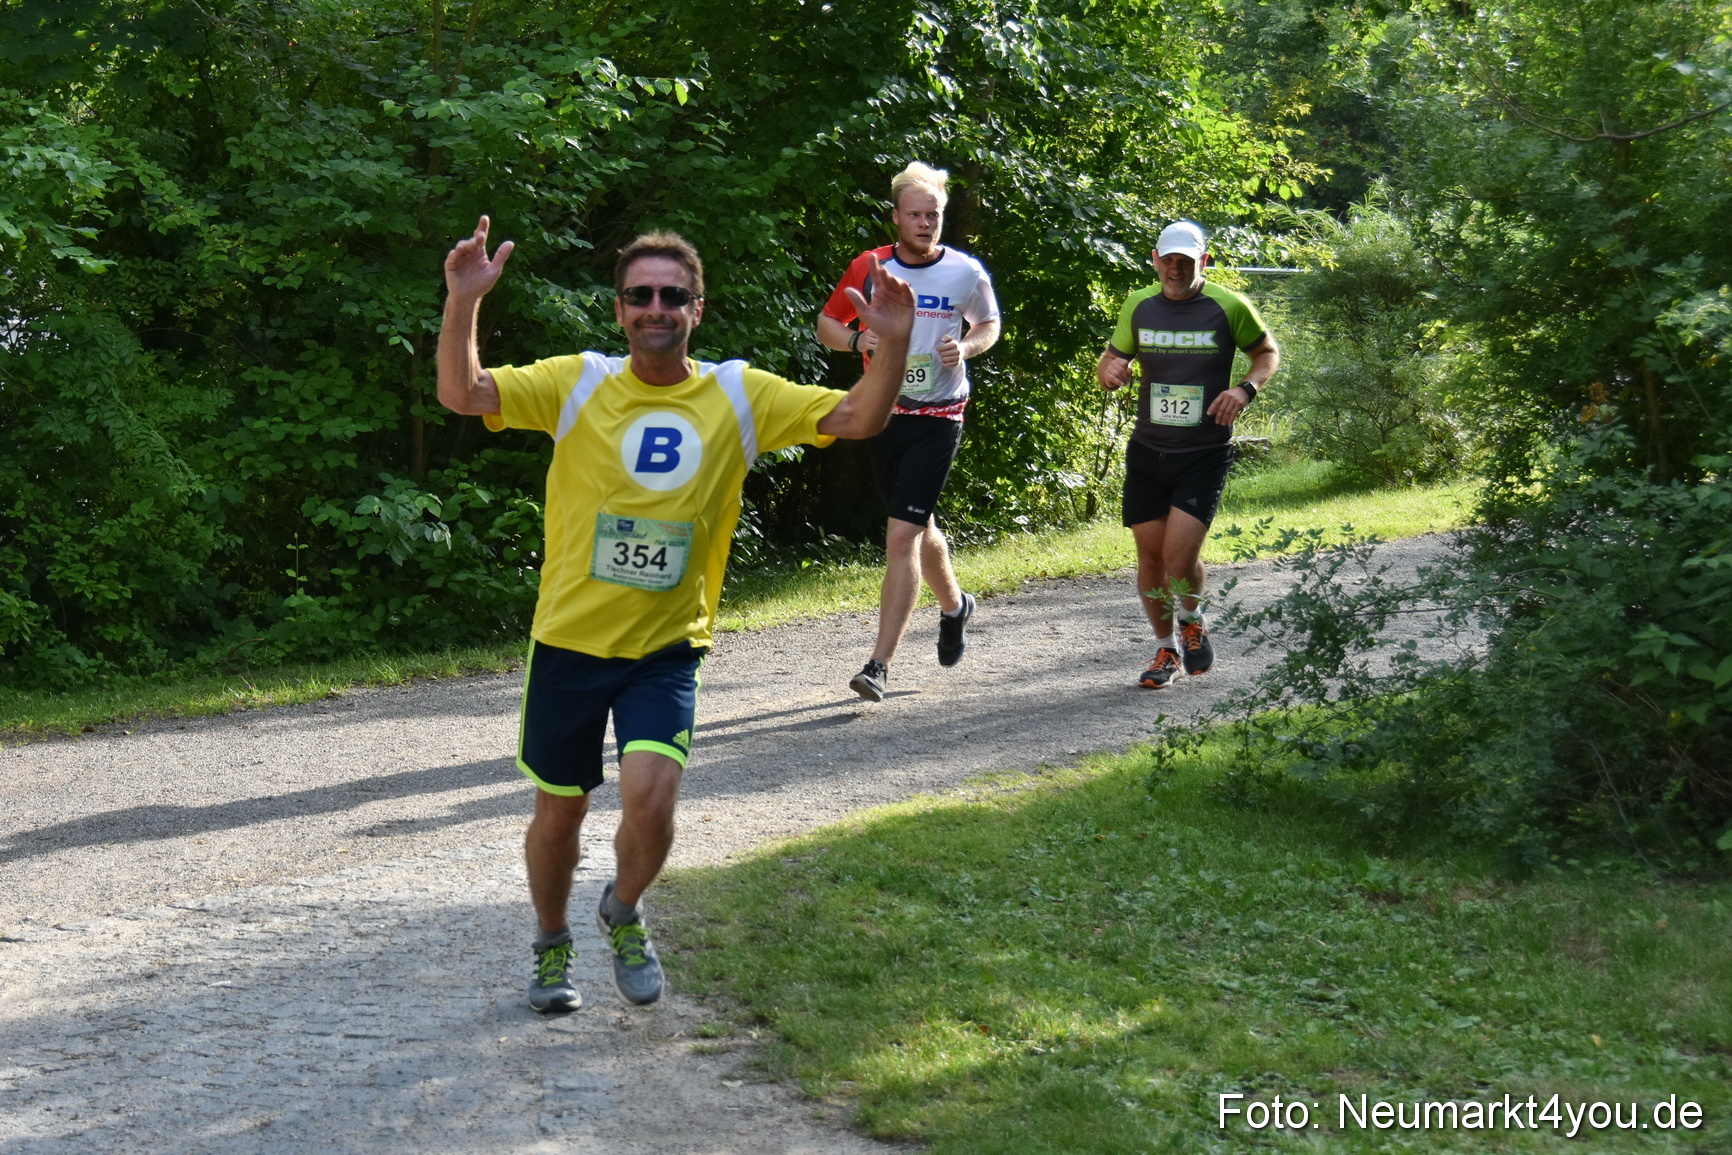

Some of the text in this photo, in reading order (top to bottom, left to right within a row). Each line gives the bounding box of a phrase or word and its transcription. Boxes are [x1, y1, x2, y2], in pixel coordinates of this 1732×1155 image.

[1139, 329, 1216, 347] BOCK
[1160, 399, 1190, 415] 312
[634, 427, 682, 473] B
[612, 541, 667, 571] 354
[606, 564, 672, 579] Tischner Reinhard
